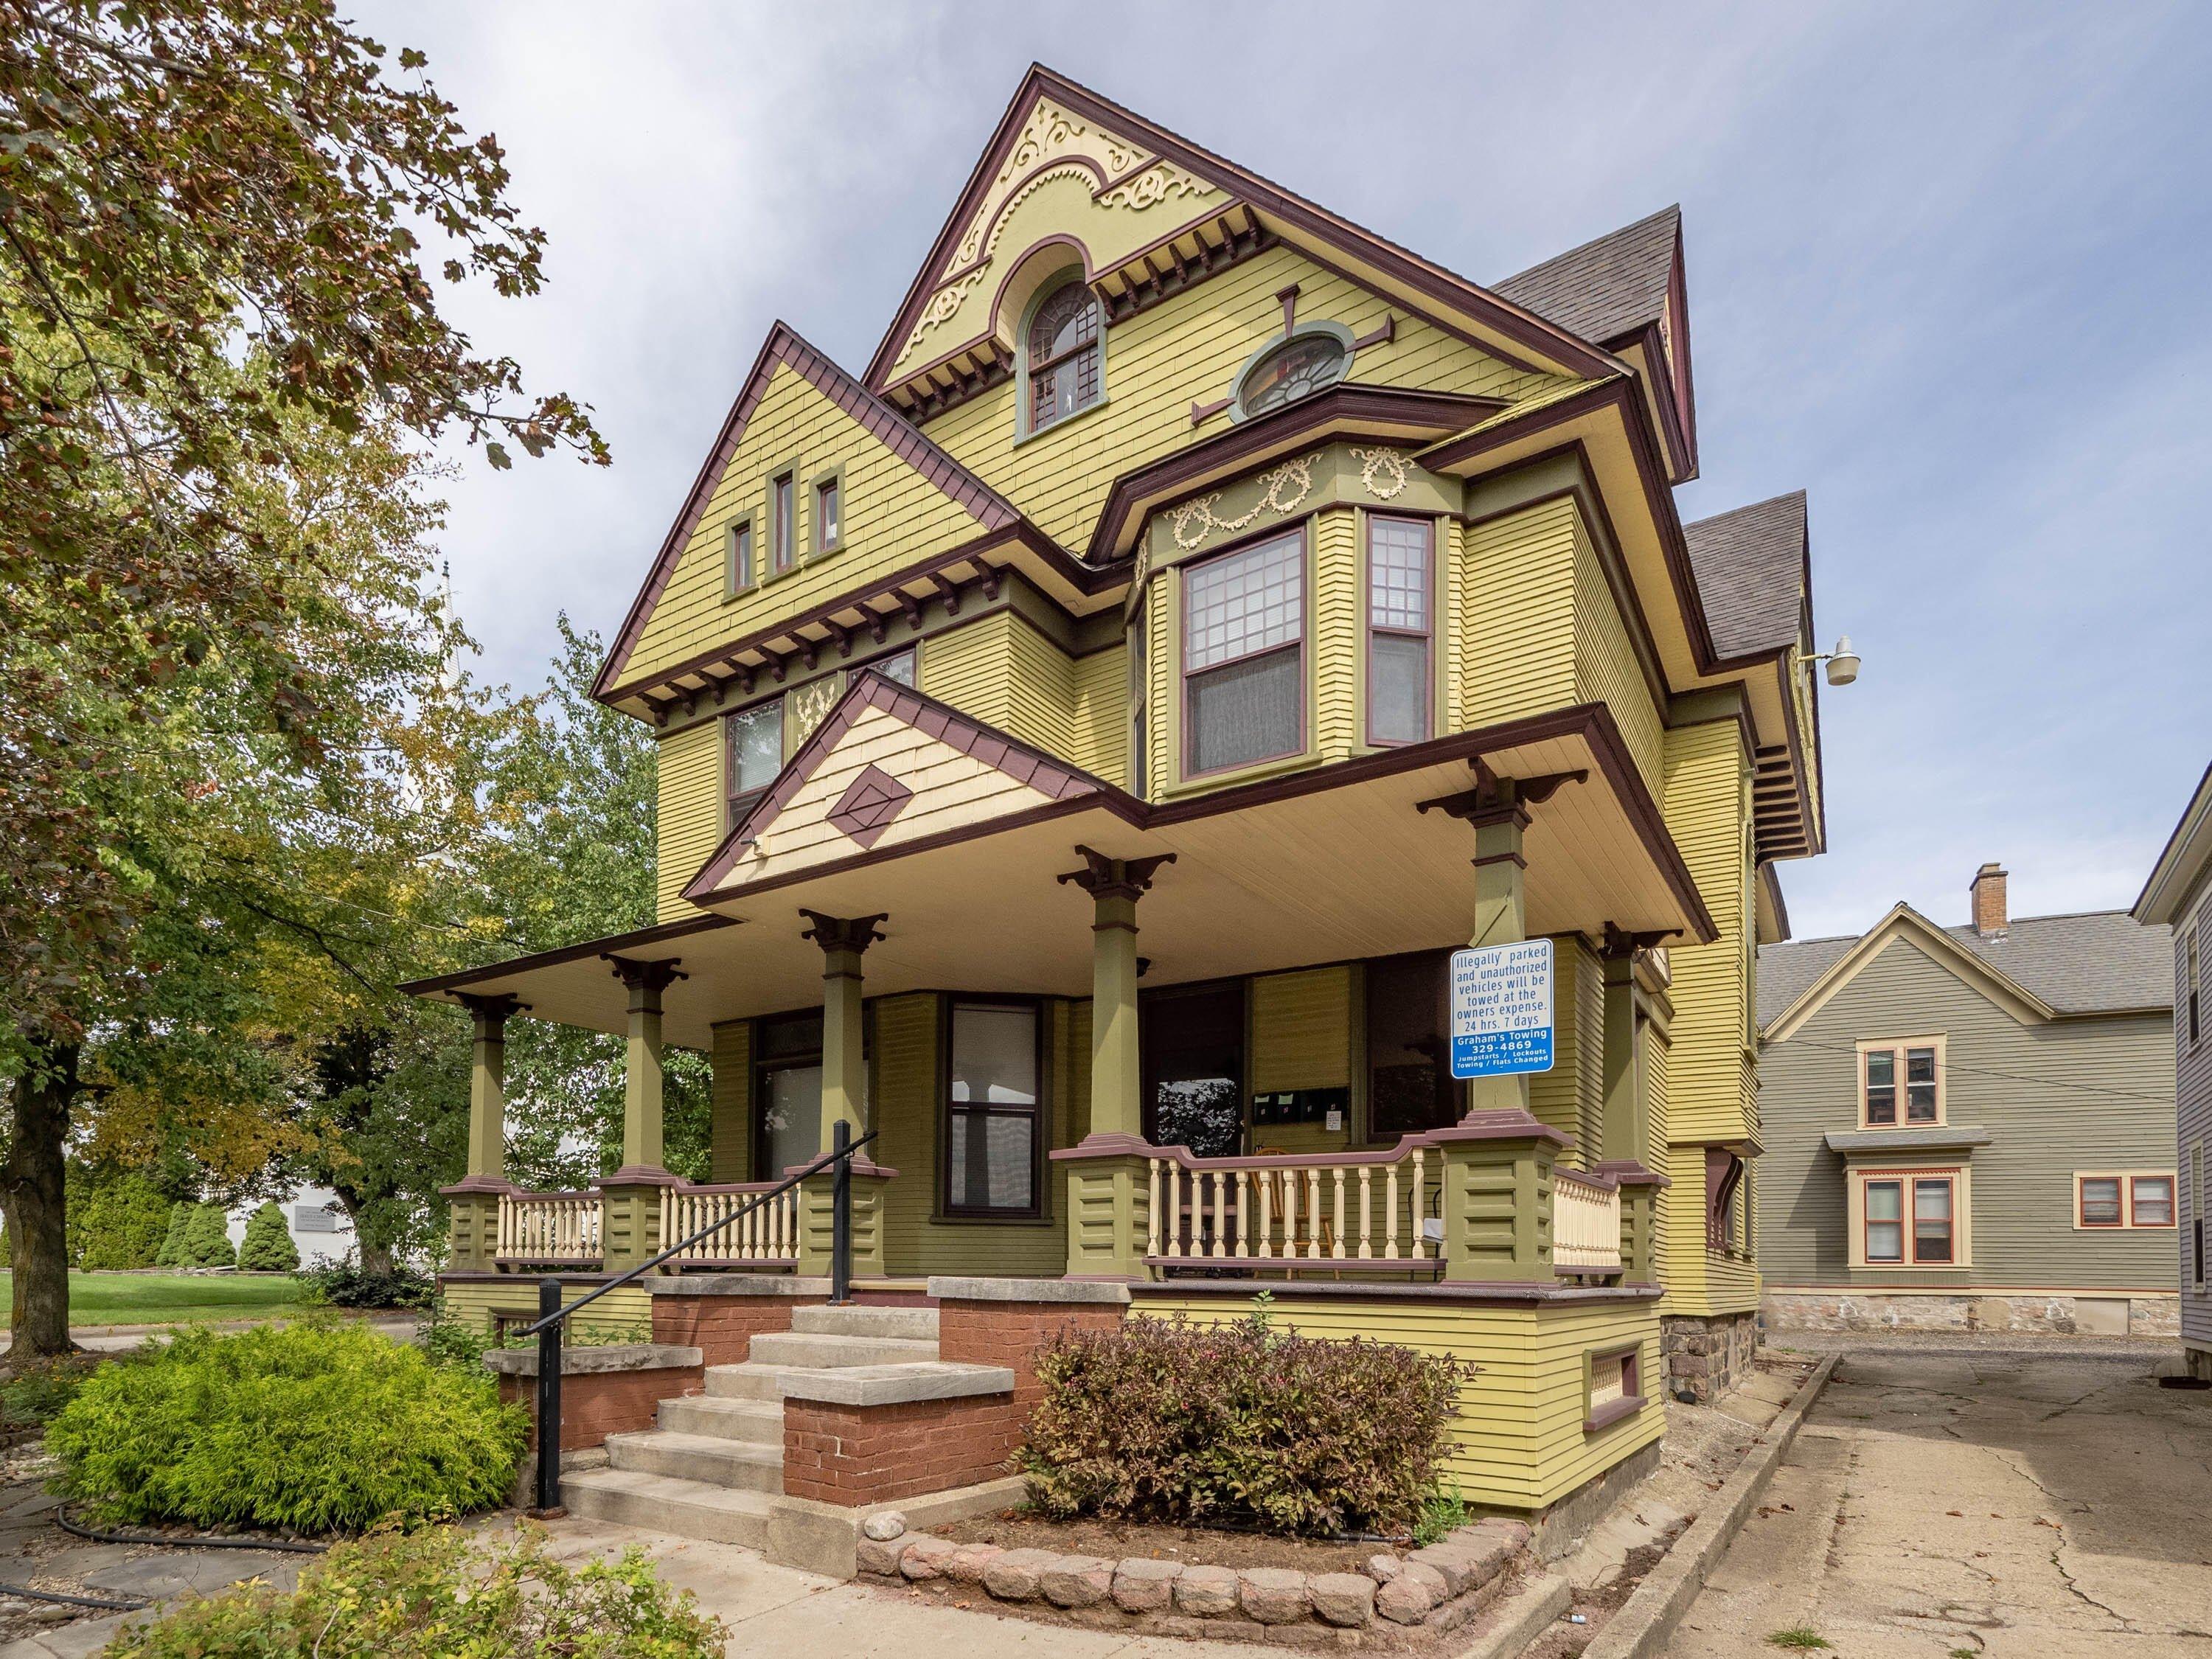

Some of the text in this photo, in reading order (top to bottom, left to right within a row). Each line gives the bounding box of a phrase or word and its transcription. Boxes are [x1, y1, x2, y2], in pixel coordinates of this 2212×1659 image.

[1457, 945, 1546, 968] Illegally parked
[1457, 960, 1546, 982] and unauthorized
[1459, 975, 1544, 995] vehicles will be
[1467, 990, 1536, 1006] towed at the
[1457, 1001, 1546, 1019] owners expense.
[1465, 1015, 1538, 1032] 24 hrs. 7 days
[1458, 1030, 1547, 1045] Graham's Towing
[1472, 1040, 1531, 1054] 329-4869
[1513, 1048, 1546, 1057] Lockouts
[1457, 1060, 1483, 1068] Towing
[1514, 1055, 1548, 1063] Changed
